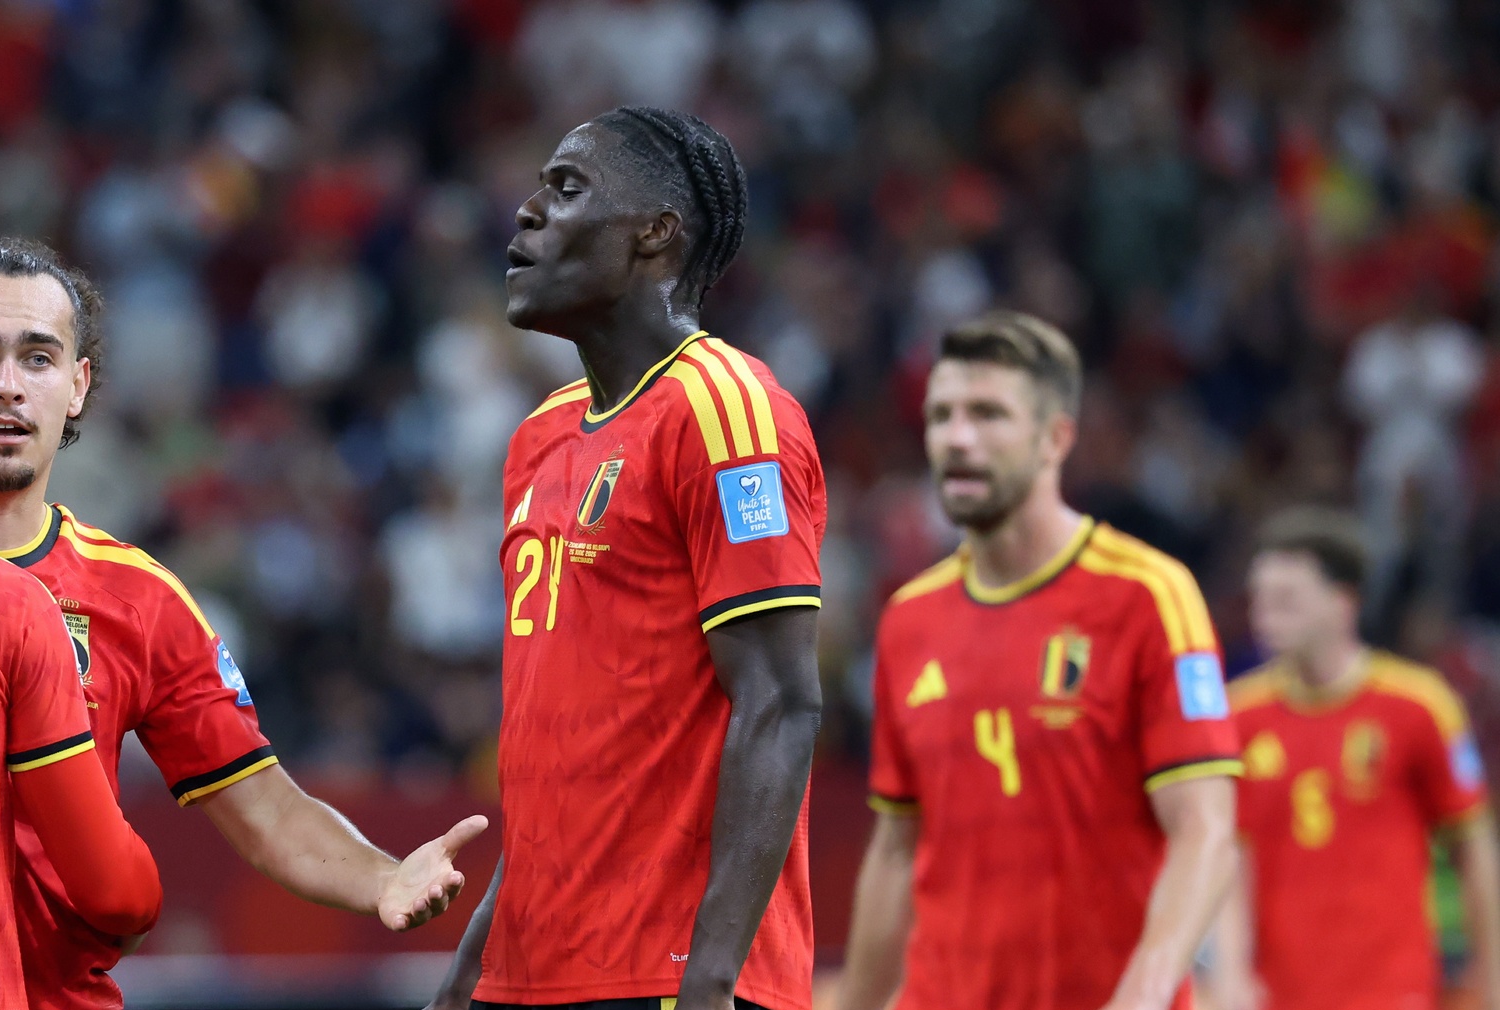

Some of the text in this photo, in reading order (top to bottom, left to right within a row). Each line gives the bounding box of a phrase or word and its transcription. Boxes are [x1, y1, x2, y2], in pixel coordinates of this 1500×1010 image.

[737, 497, 759, 513] Unite
[742, 507, 773, 525] PEACE
[750, 522, 768, 532] FIFA
[510, 534, 564, 637] 24
[974, 707, 1021, 797] 4
